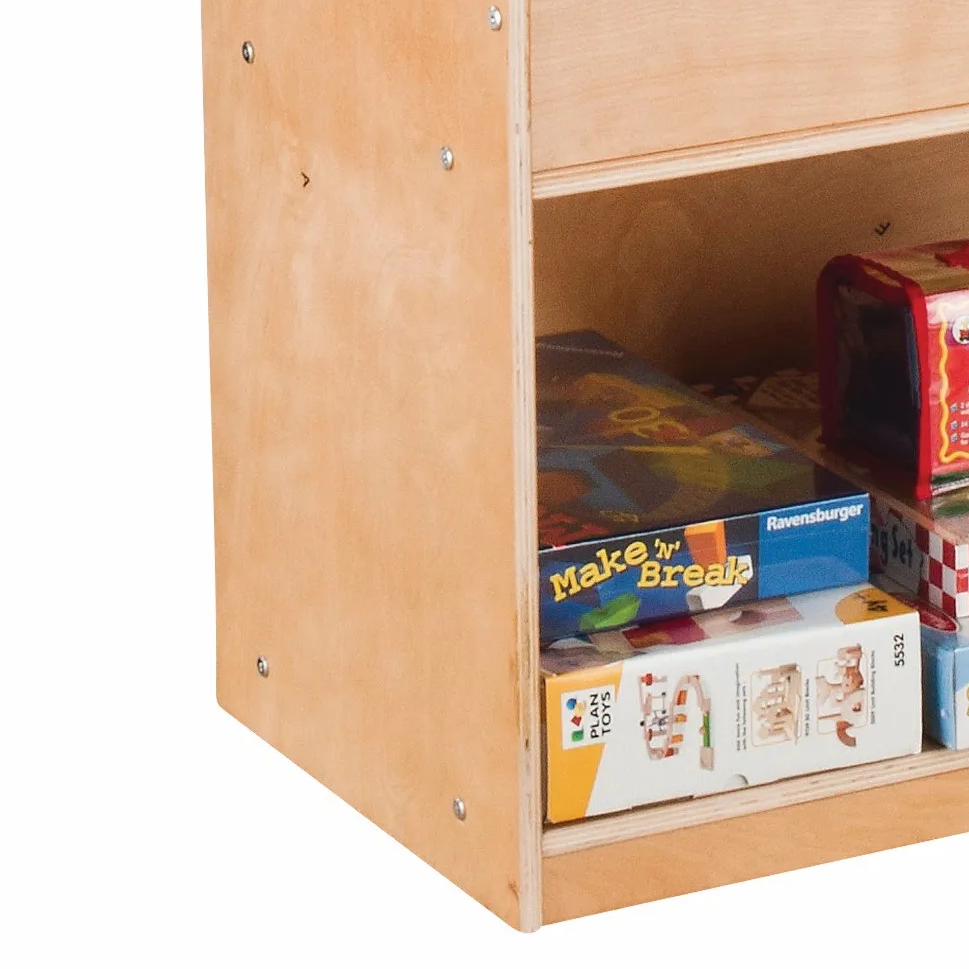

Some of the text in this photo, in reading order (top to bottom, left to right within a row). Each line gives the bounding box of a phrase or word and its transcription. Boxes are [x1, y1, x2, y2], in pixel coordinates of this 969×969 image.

[766, 503, 863, 532] Ravensburger
[550, 539, 648, 603] Make
[637, 556, 748, 589] Break
[893, 633, 905, 668] 5532
[590, 693, 600, 739] PLAN
[601, 691, 611, 737] TOYS
